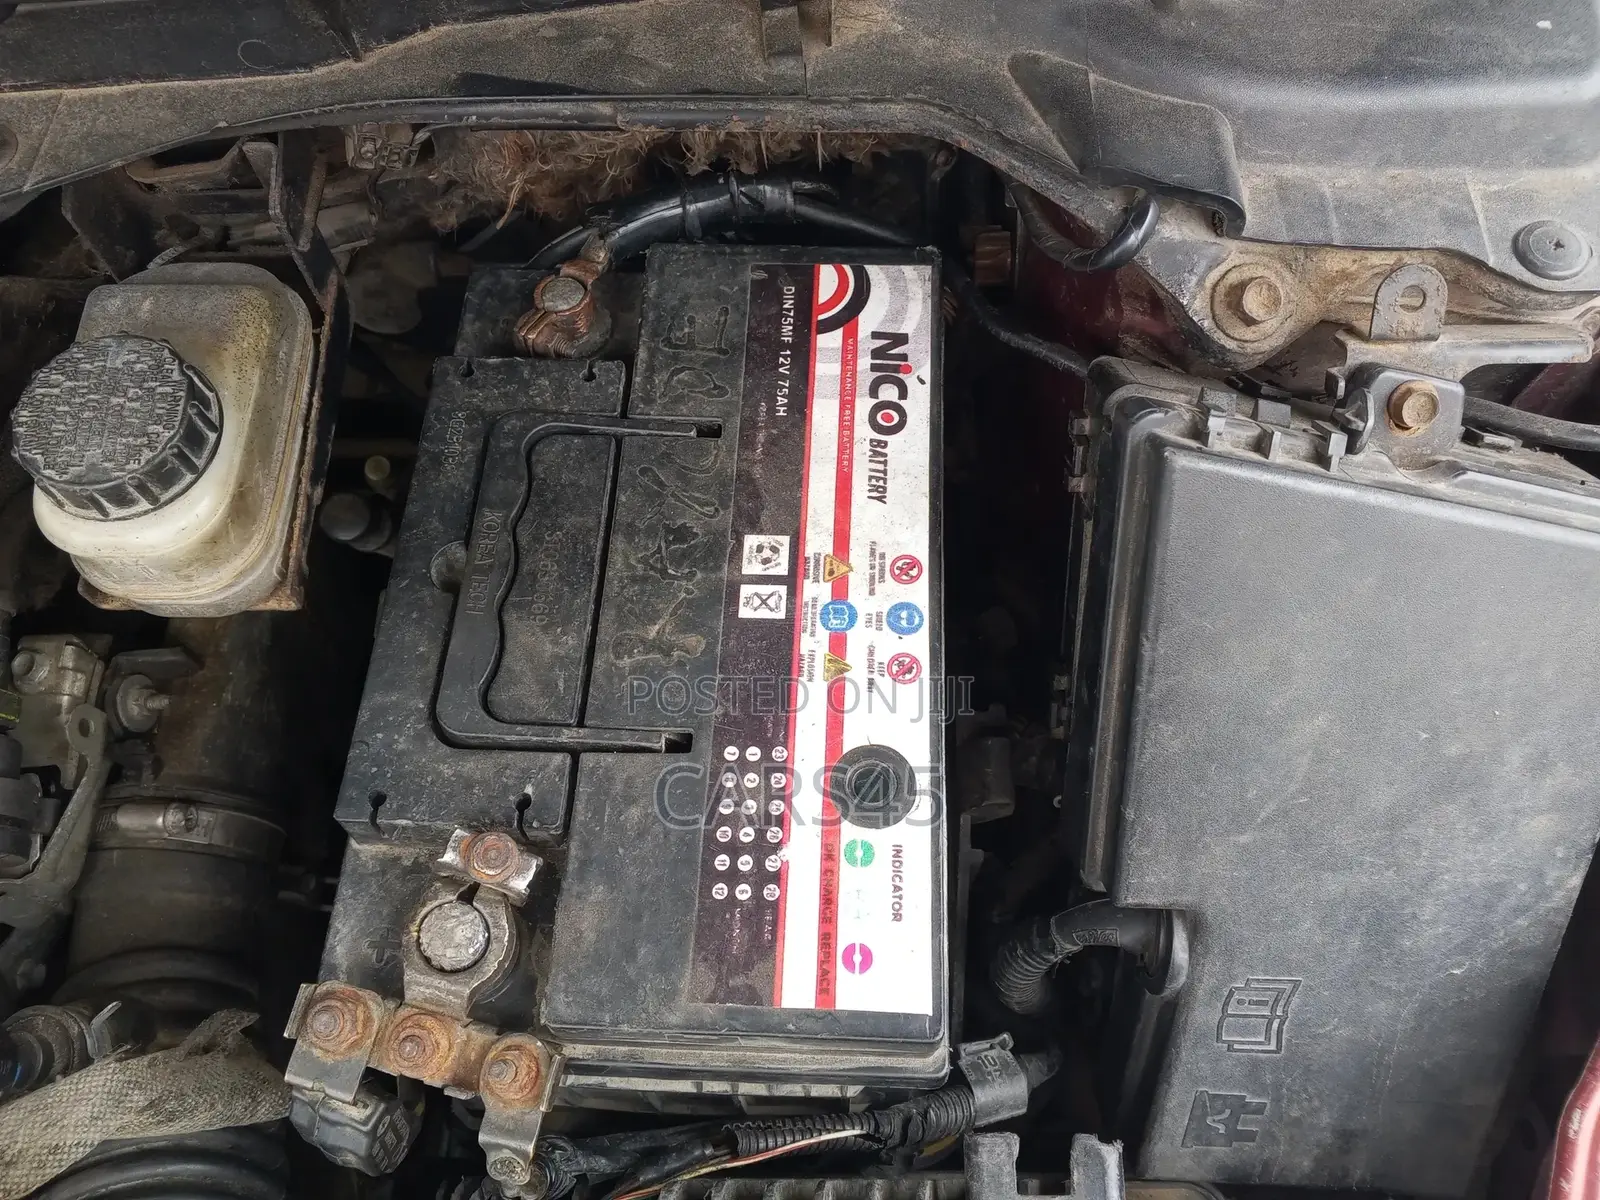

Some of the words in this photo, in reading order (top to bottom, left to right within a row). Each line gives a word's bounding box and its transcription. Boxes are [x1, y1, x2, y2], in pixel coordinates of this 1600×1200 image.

[780, 286, 795, 344] DIN75MF
[778, 350, 791, 375] 12V
[844, 338, 854, 401] MAINTENANCE
[775, 379, 789, 416] 75AH
[843, 404, 851, 430] FREE
[841, 431, 850, 472] BATTERY
[867, 438, 888, 504] BATTERY
[475, 507, 502, 565] KOREA
[465, 575, 490, 615] TECH
[821, 869, 834, 924] CHARGE
[891, 844, 903, 922] INDICATOR
[819, 932, 832, 996] REPLACE
